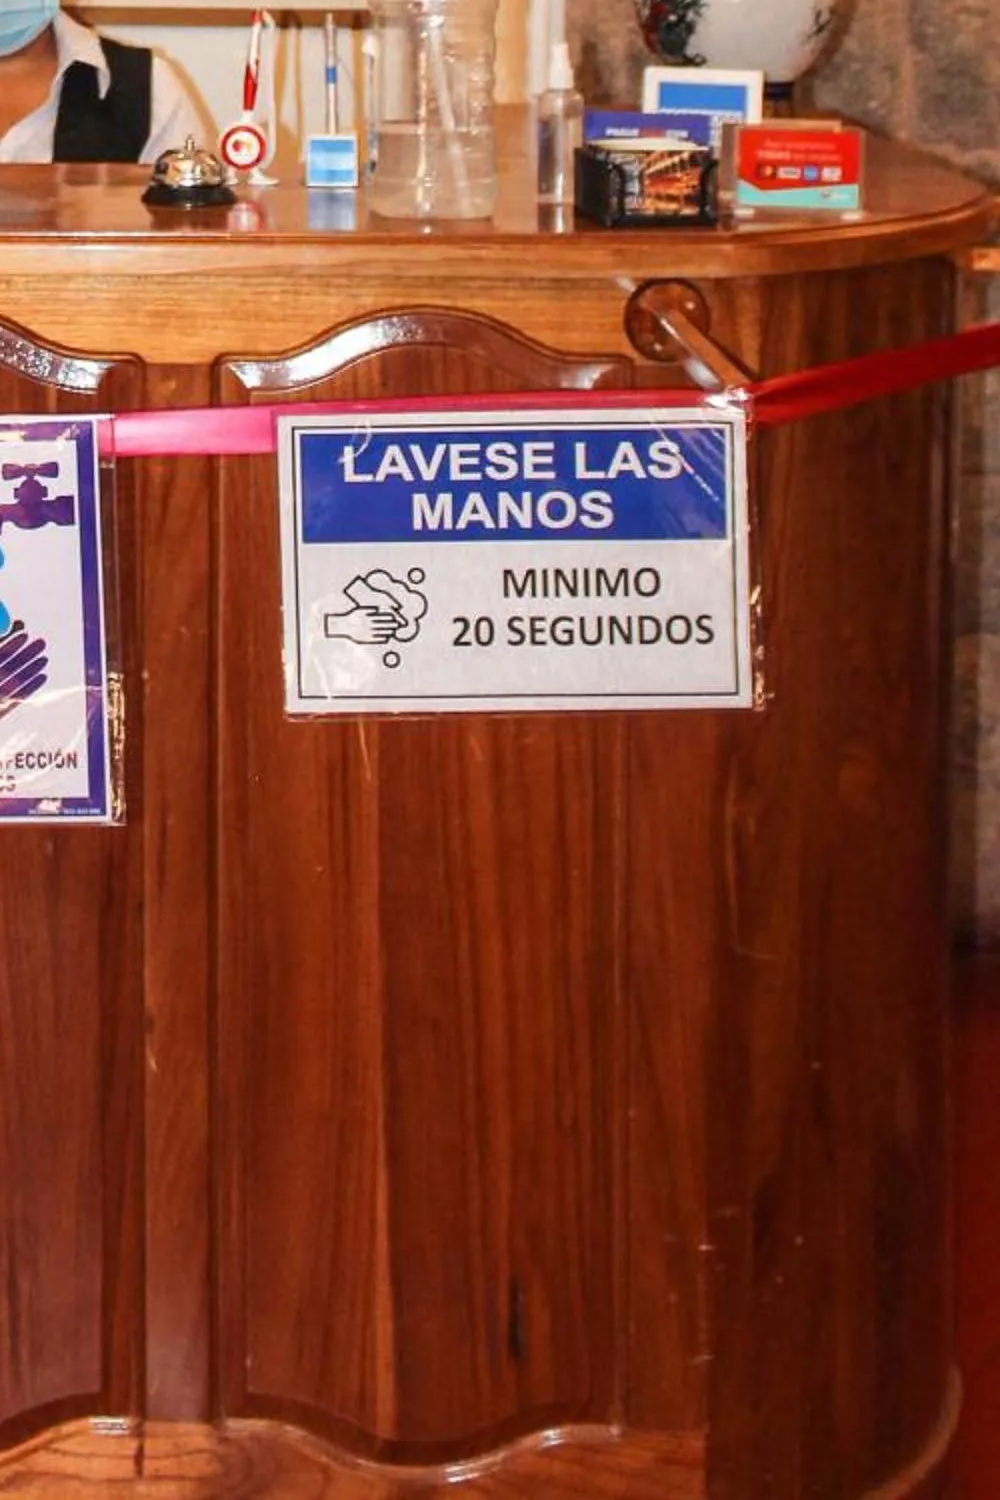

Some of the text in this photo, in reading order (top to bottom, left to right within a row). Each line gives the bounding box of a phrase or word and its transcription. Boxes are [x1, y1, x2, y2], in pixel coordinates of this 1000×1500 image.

[343, 441, 681, 483] LAVESE LAS
[412, 491, 613, 531] MANOS
[502, 567, 661, 599] MINIMO
[452, 615, 715, 647] 20 SEGUNDOS
